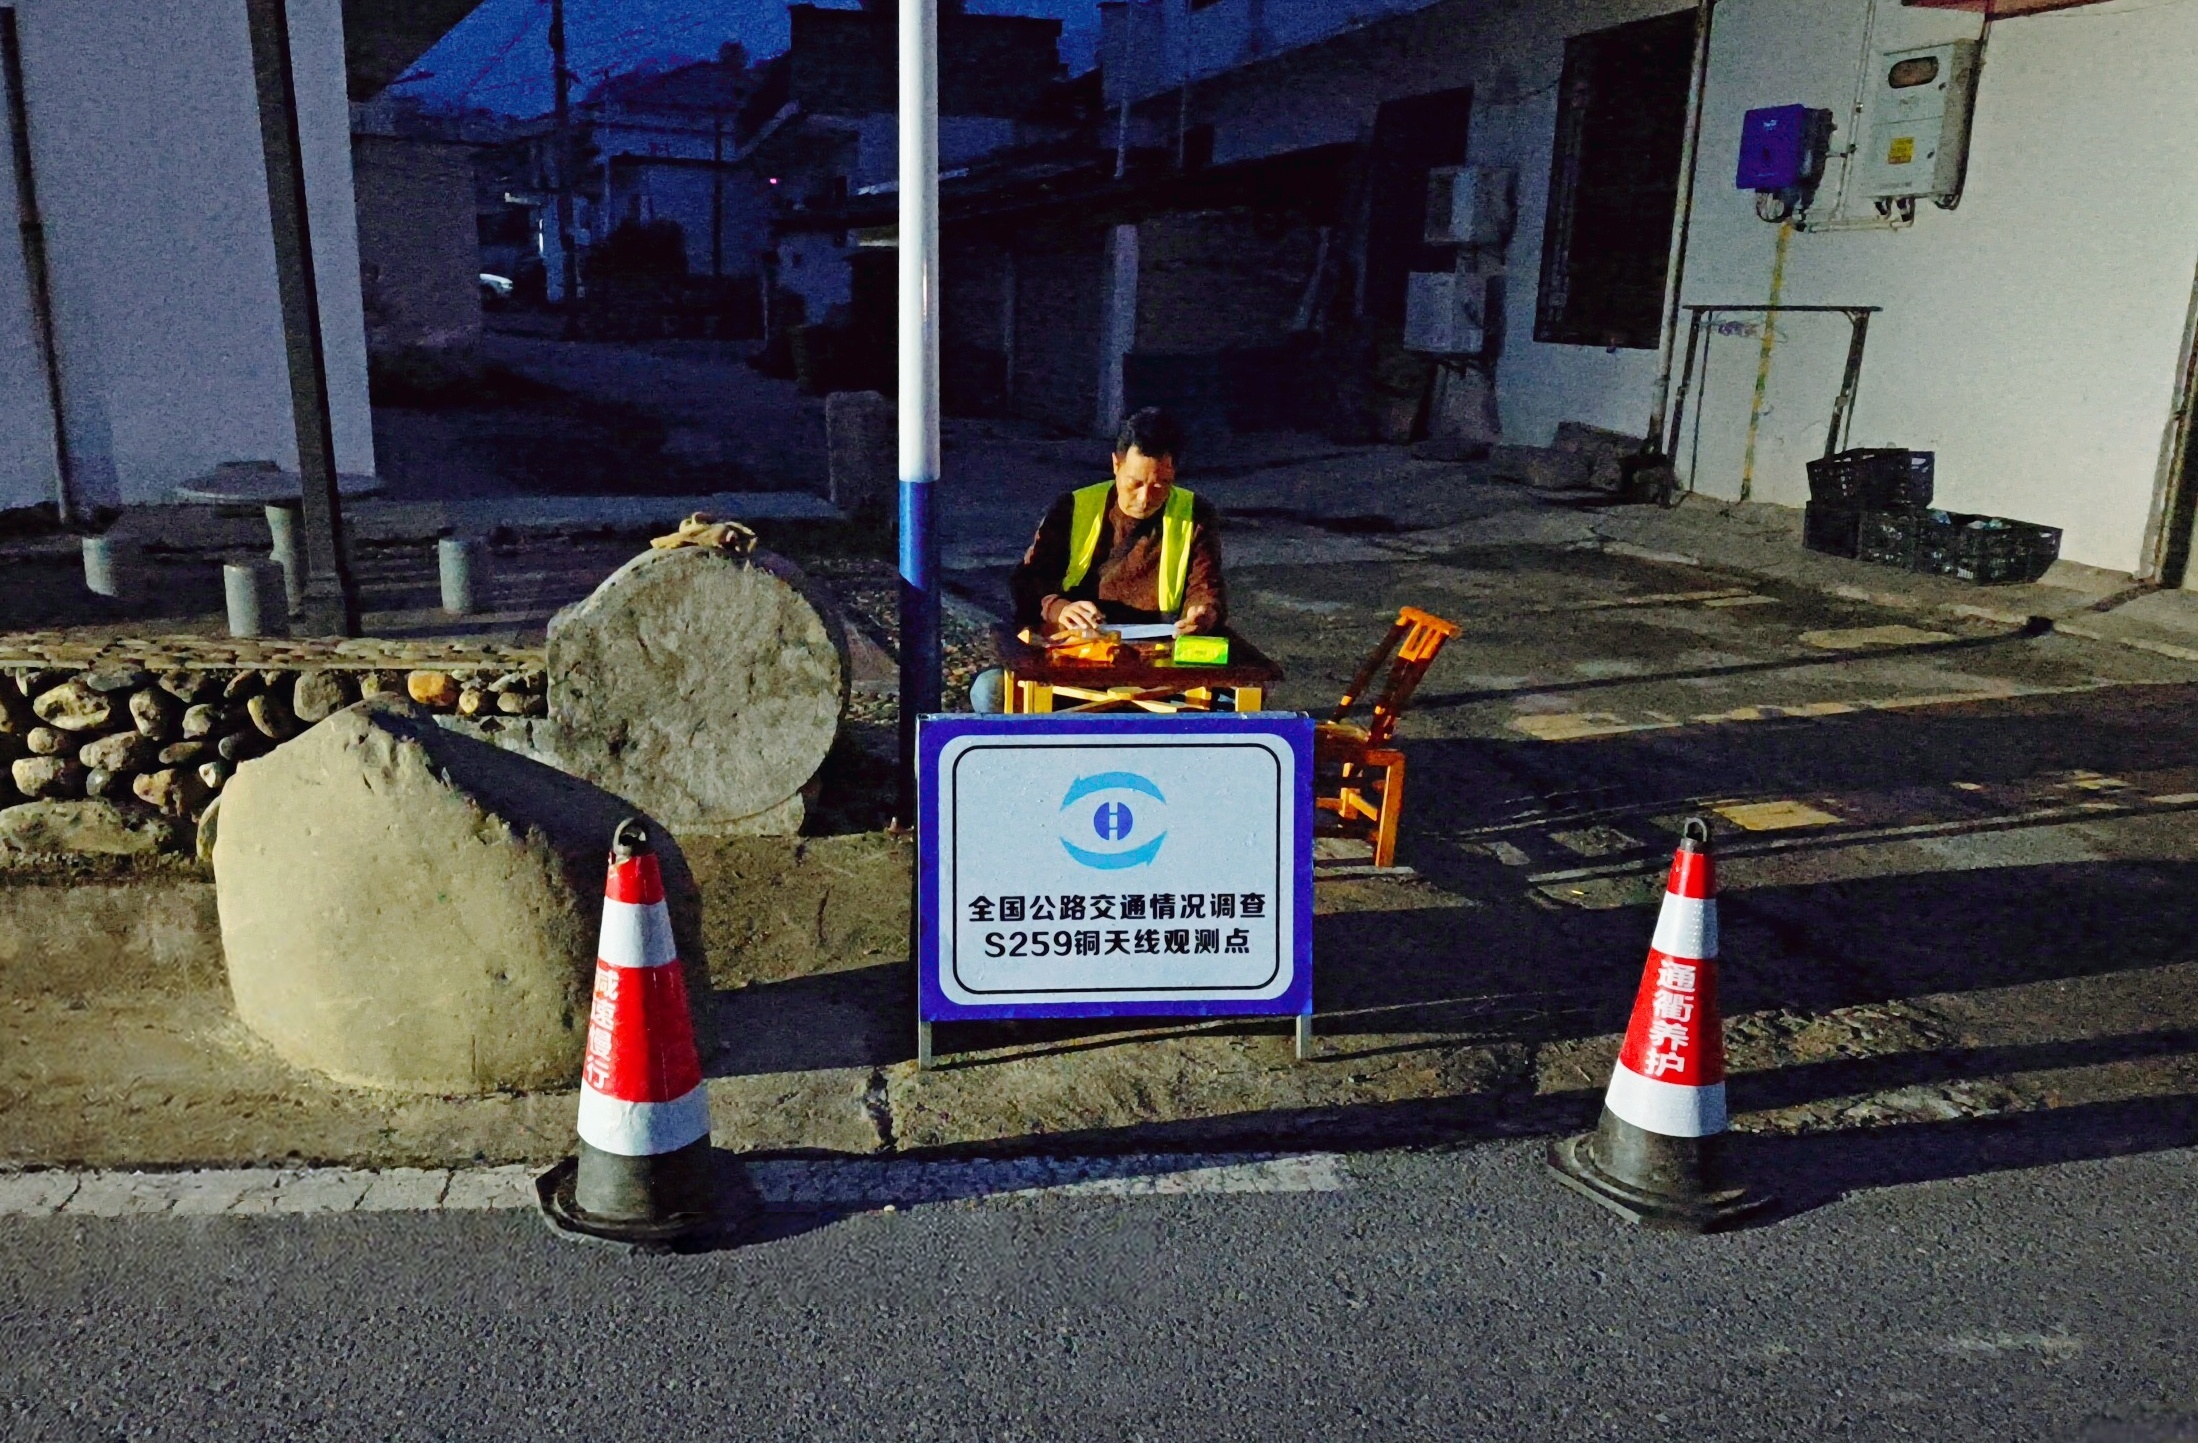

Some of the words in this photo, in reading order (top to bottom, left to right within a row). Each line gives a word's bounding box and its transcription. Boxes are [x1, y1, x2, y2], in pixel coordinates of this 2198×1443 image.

[969, 892, 1266, 921] 全国公路交通情况调查
[984, 928, 1250, 958] S259铜天线观测点
[1644, 959, 1696, 1077] 通衢养护
